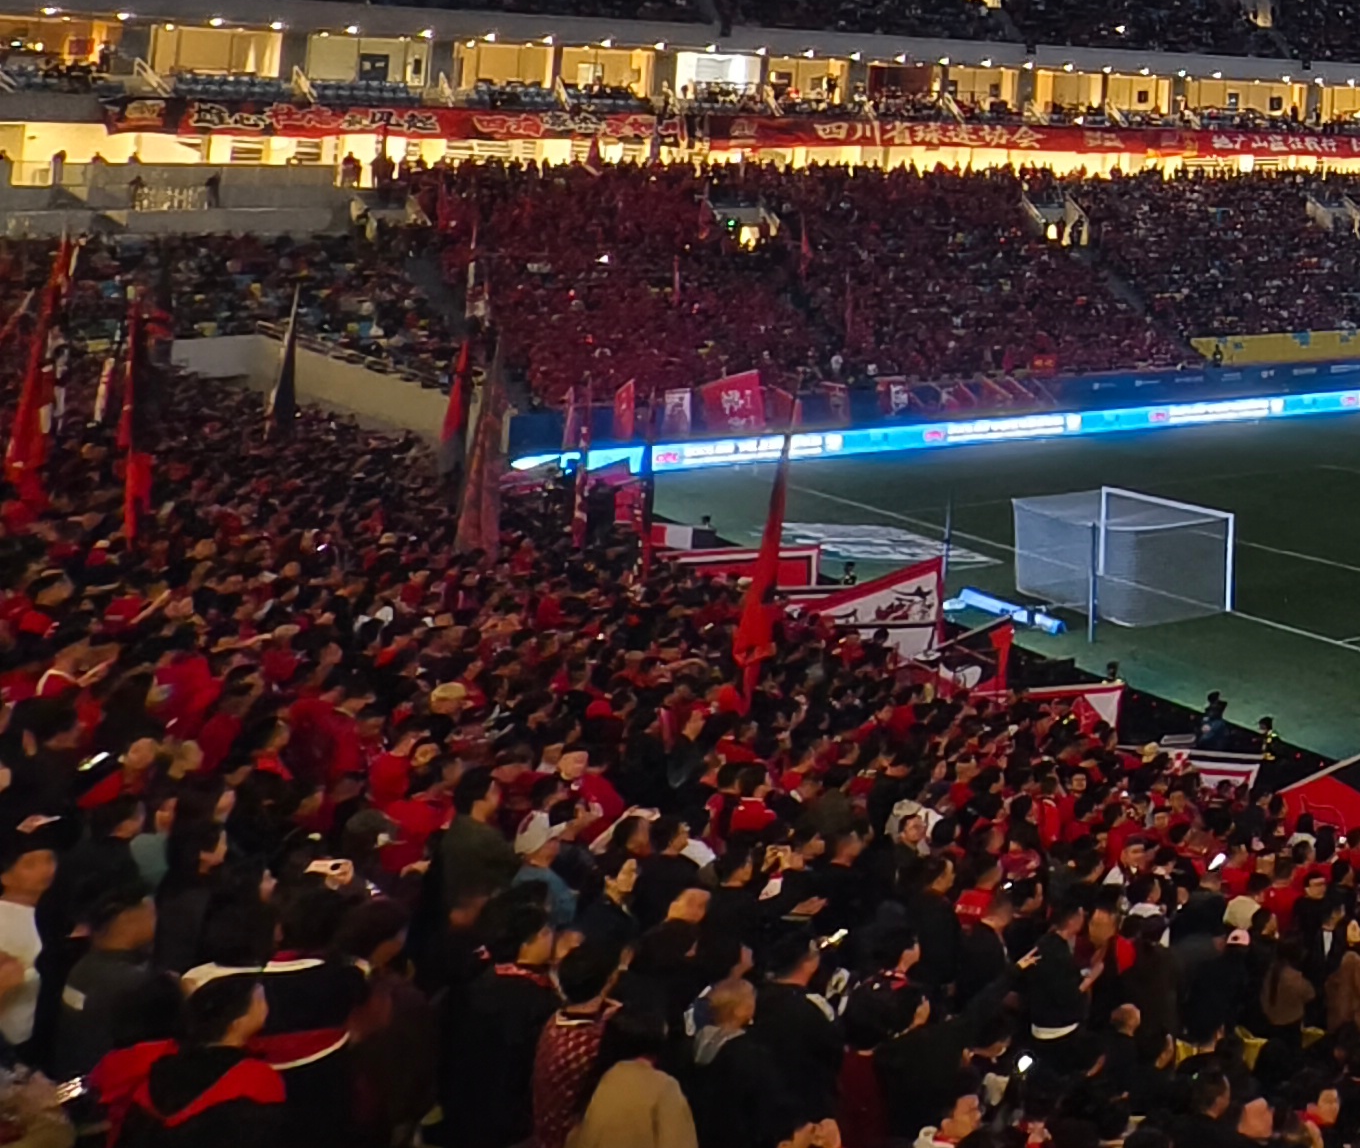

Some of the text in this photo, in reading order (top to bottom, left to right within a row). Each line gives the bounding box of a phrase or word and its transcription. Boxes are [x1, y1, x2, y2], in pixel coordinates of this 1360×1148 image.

[812, 120, 1048, 150] 四川省球迷协会
